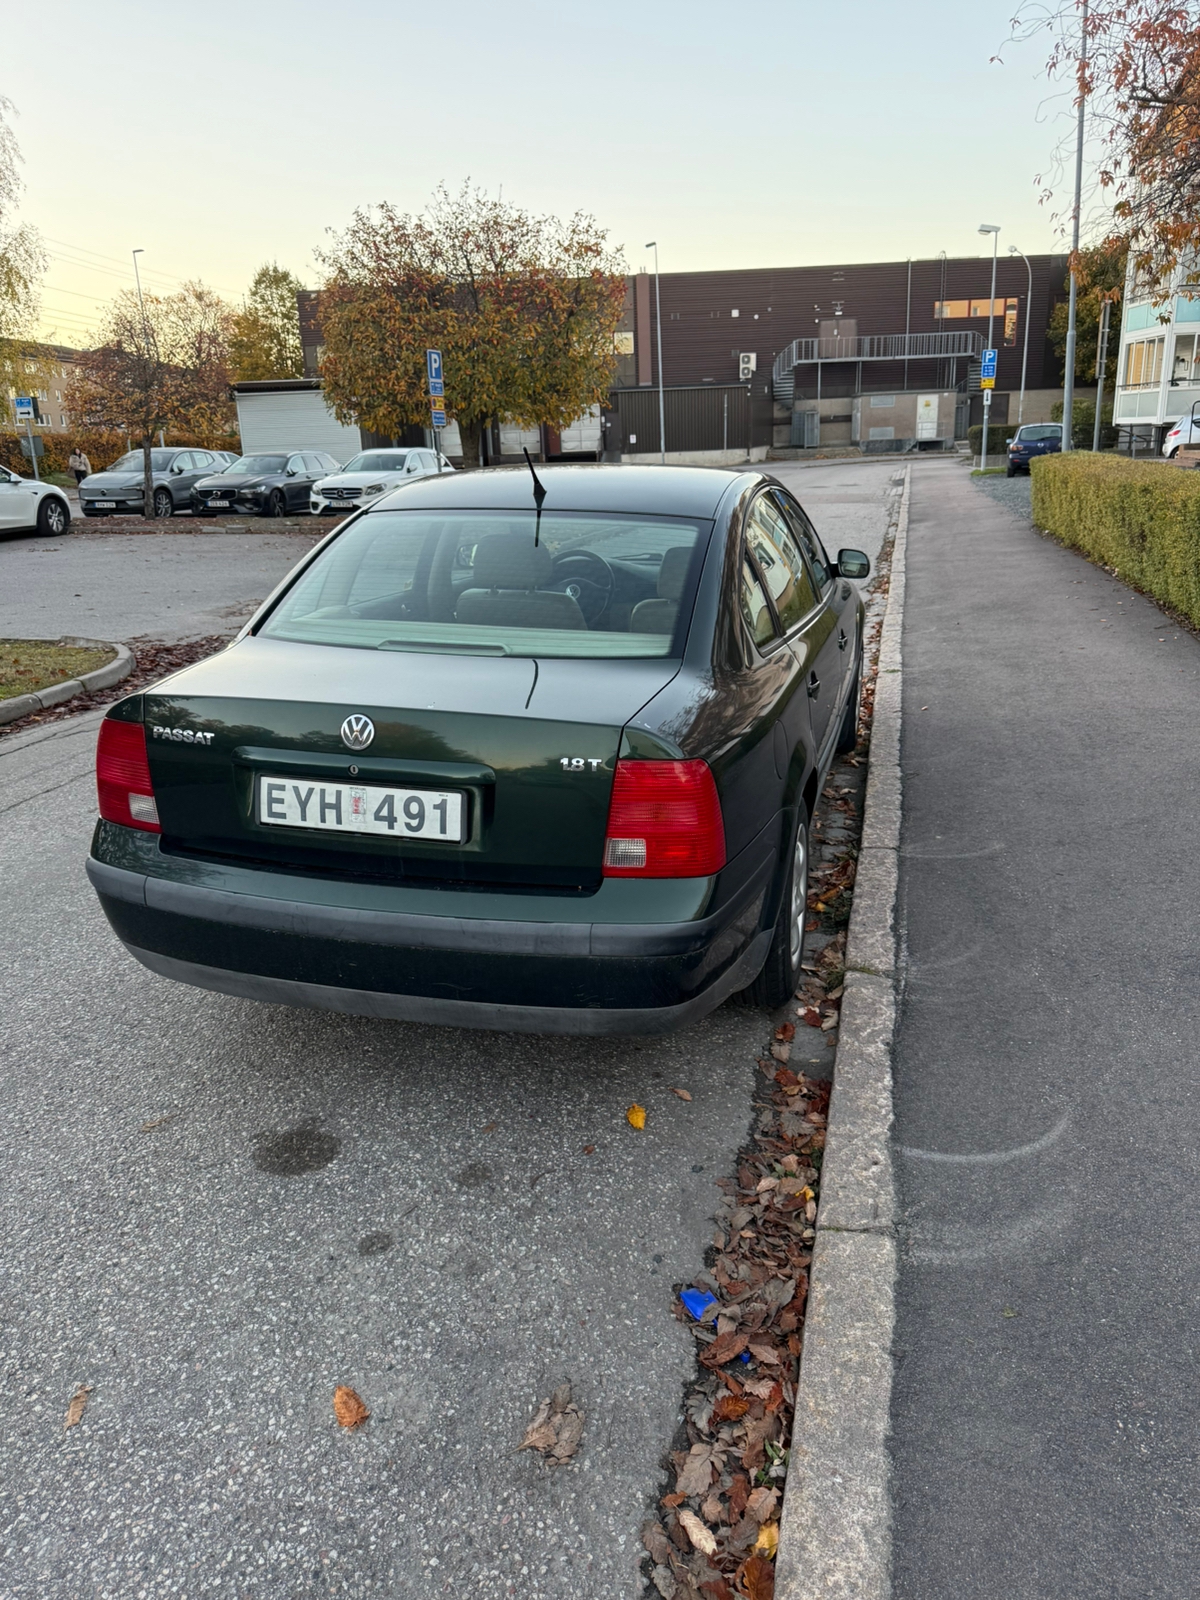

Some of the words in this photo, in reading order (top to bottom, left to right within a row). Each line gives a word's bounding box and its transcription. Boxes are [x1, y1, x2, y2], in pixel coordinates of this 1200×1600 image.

[431, 353, 440, 377] P
[985, 351, 994, 363] P
[152, 725, 215, 746] PASSAT
[266, 782, 343, 826] EYH
[373, 793, 448, 835] 491
